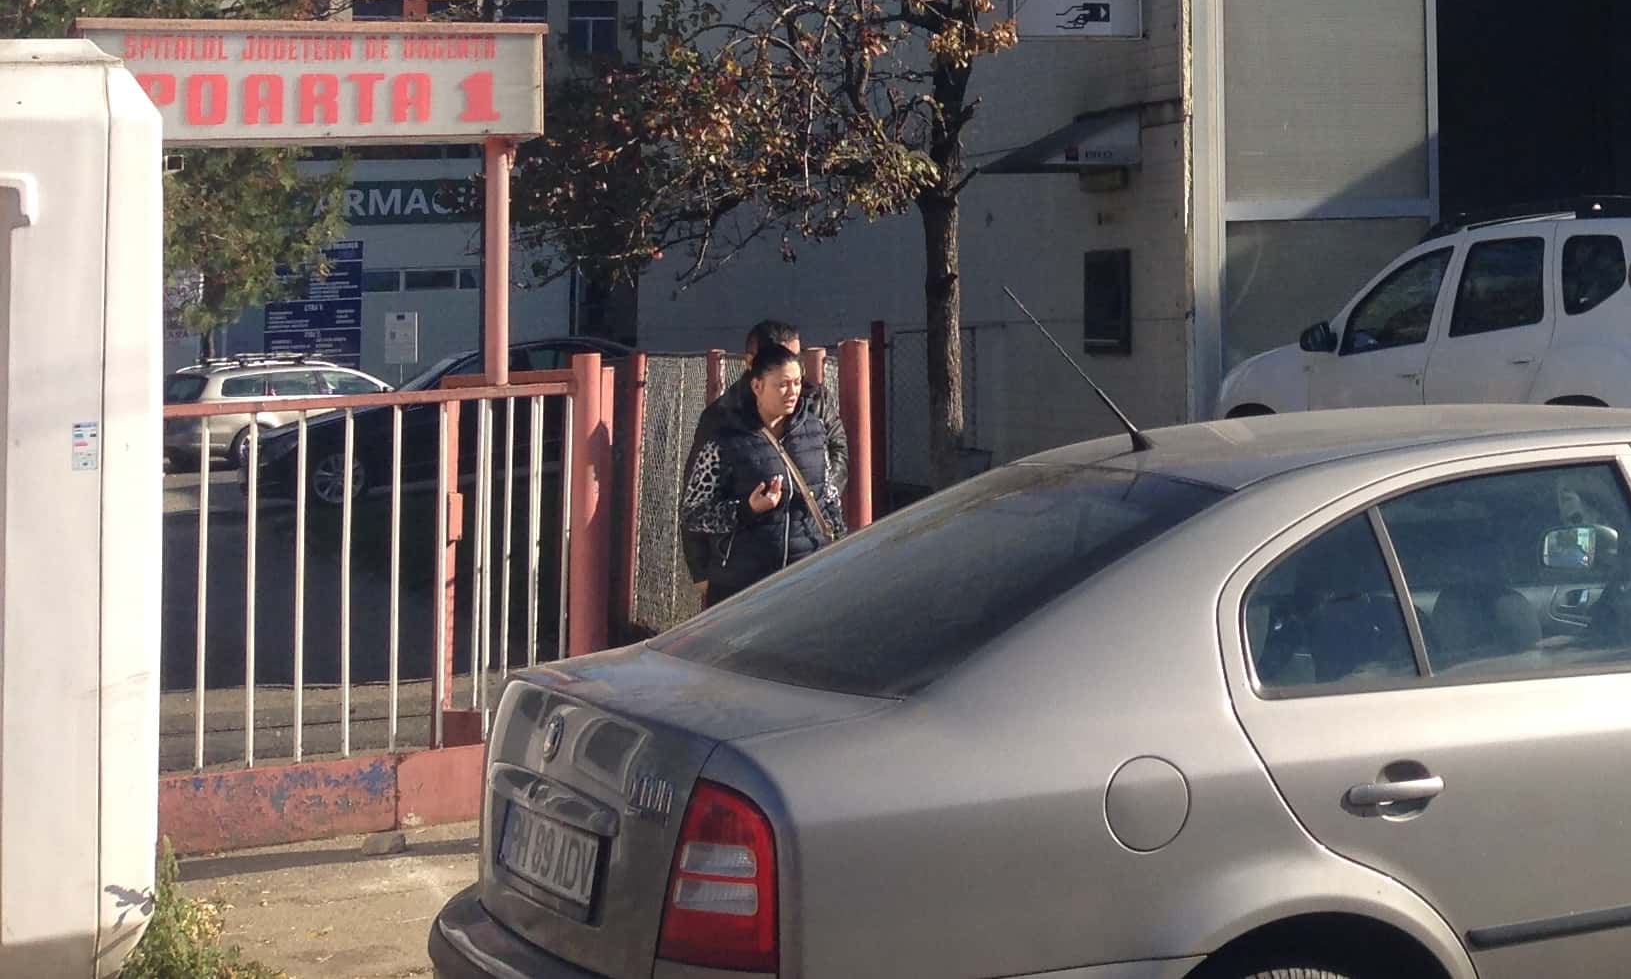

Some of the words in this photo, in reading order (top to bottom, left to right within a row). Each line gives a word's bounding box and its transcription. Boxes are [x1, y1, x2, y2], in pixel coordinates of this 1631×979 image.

[364, 34, 390, 60] DE
[136, 73, 432, 126] POARTA
[458, 70, 502, 123] 1
